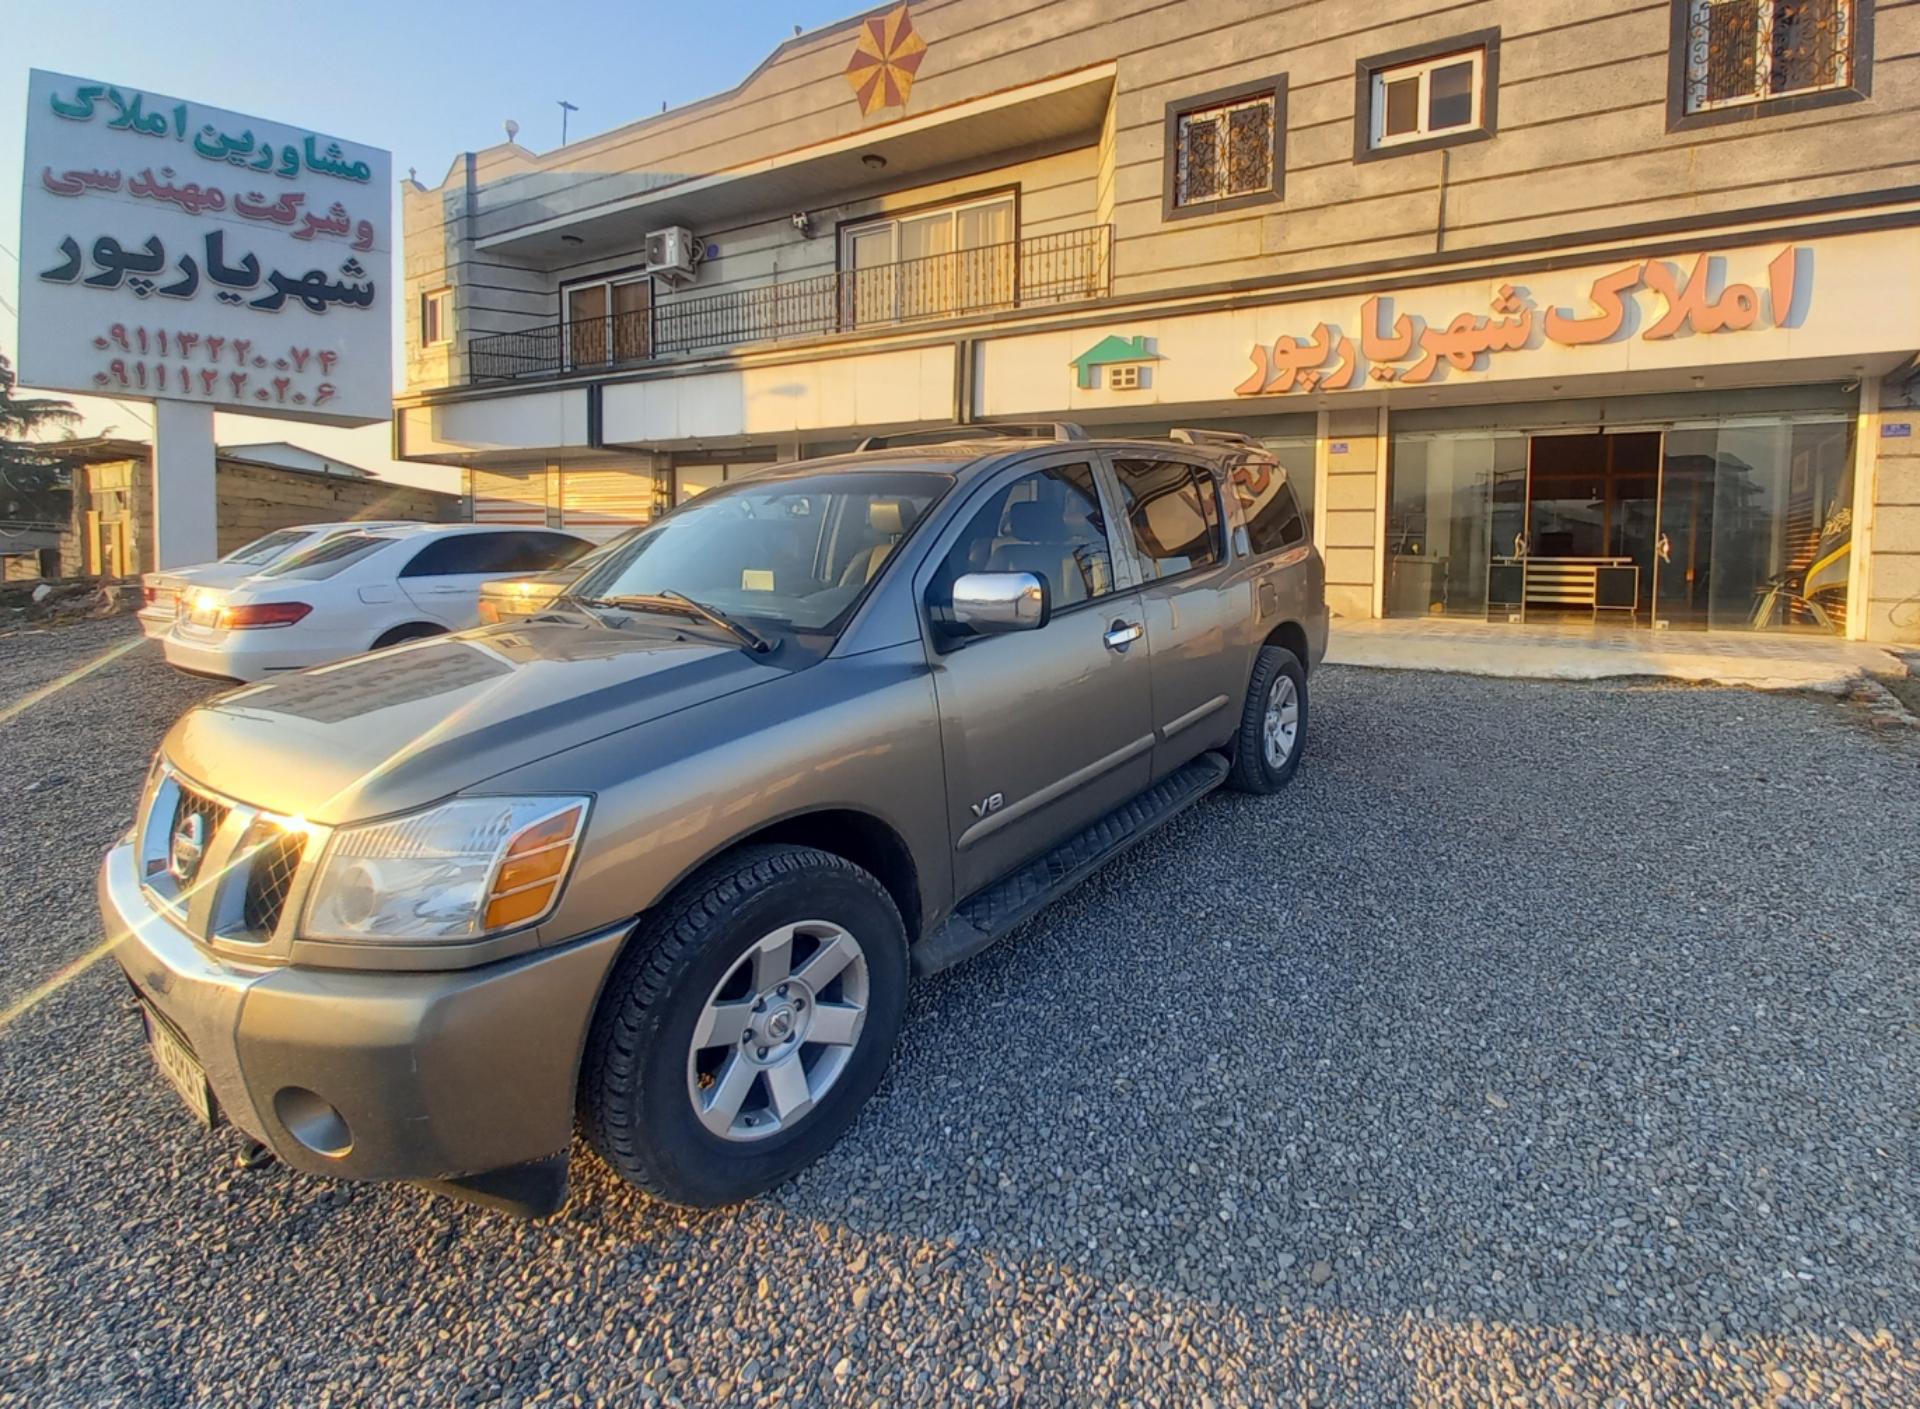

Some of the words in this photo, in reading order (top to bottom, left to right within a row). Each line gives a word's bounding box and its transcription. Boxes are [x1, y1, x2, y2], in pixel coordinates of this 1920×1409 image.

[50, 85, 188, 140] املاک
[193, 124, 372, 184] مشاورین
[42, 165, 227, 215] مهندسی
[1544, 244, 1797, 346] املاک
[970, 792, 1003, 817] V8
